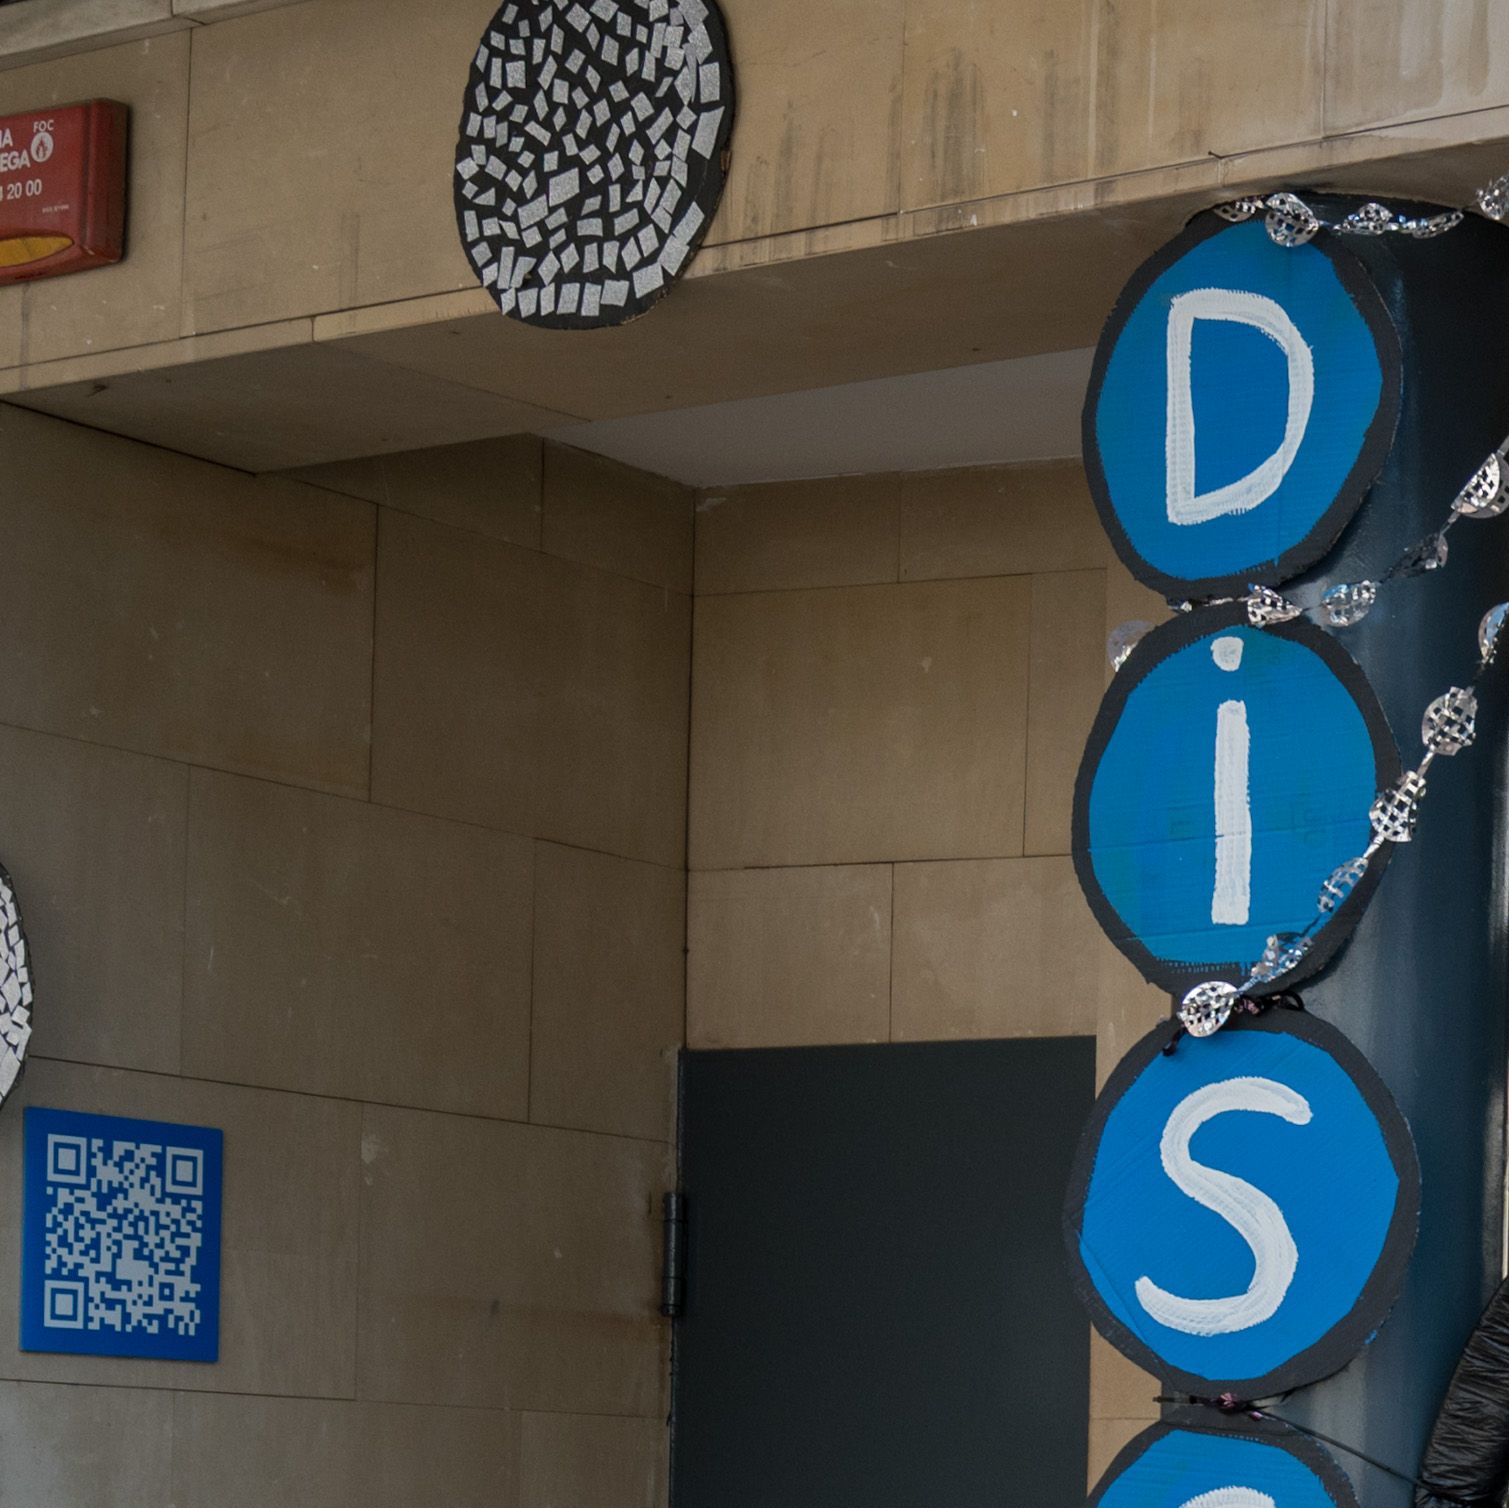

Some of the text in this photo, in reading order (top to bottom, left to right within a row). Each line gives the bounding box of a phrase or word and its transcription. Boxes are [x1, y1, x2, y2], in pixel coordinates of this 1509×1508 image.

[32, 119, 55, 133] FOC
[6, 182, 23, 200] 20
[25, 178, 42, 197] 00
